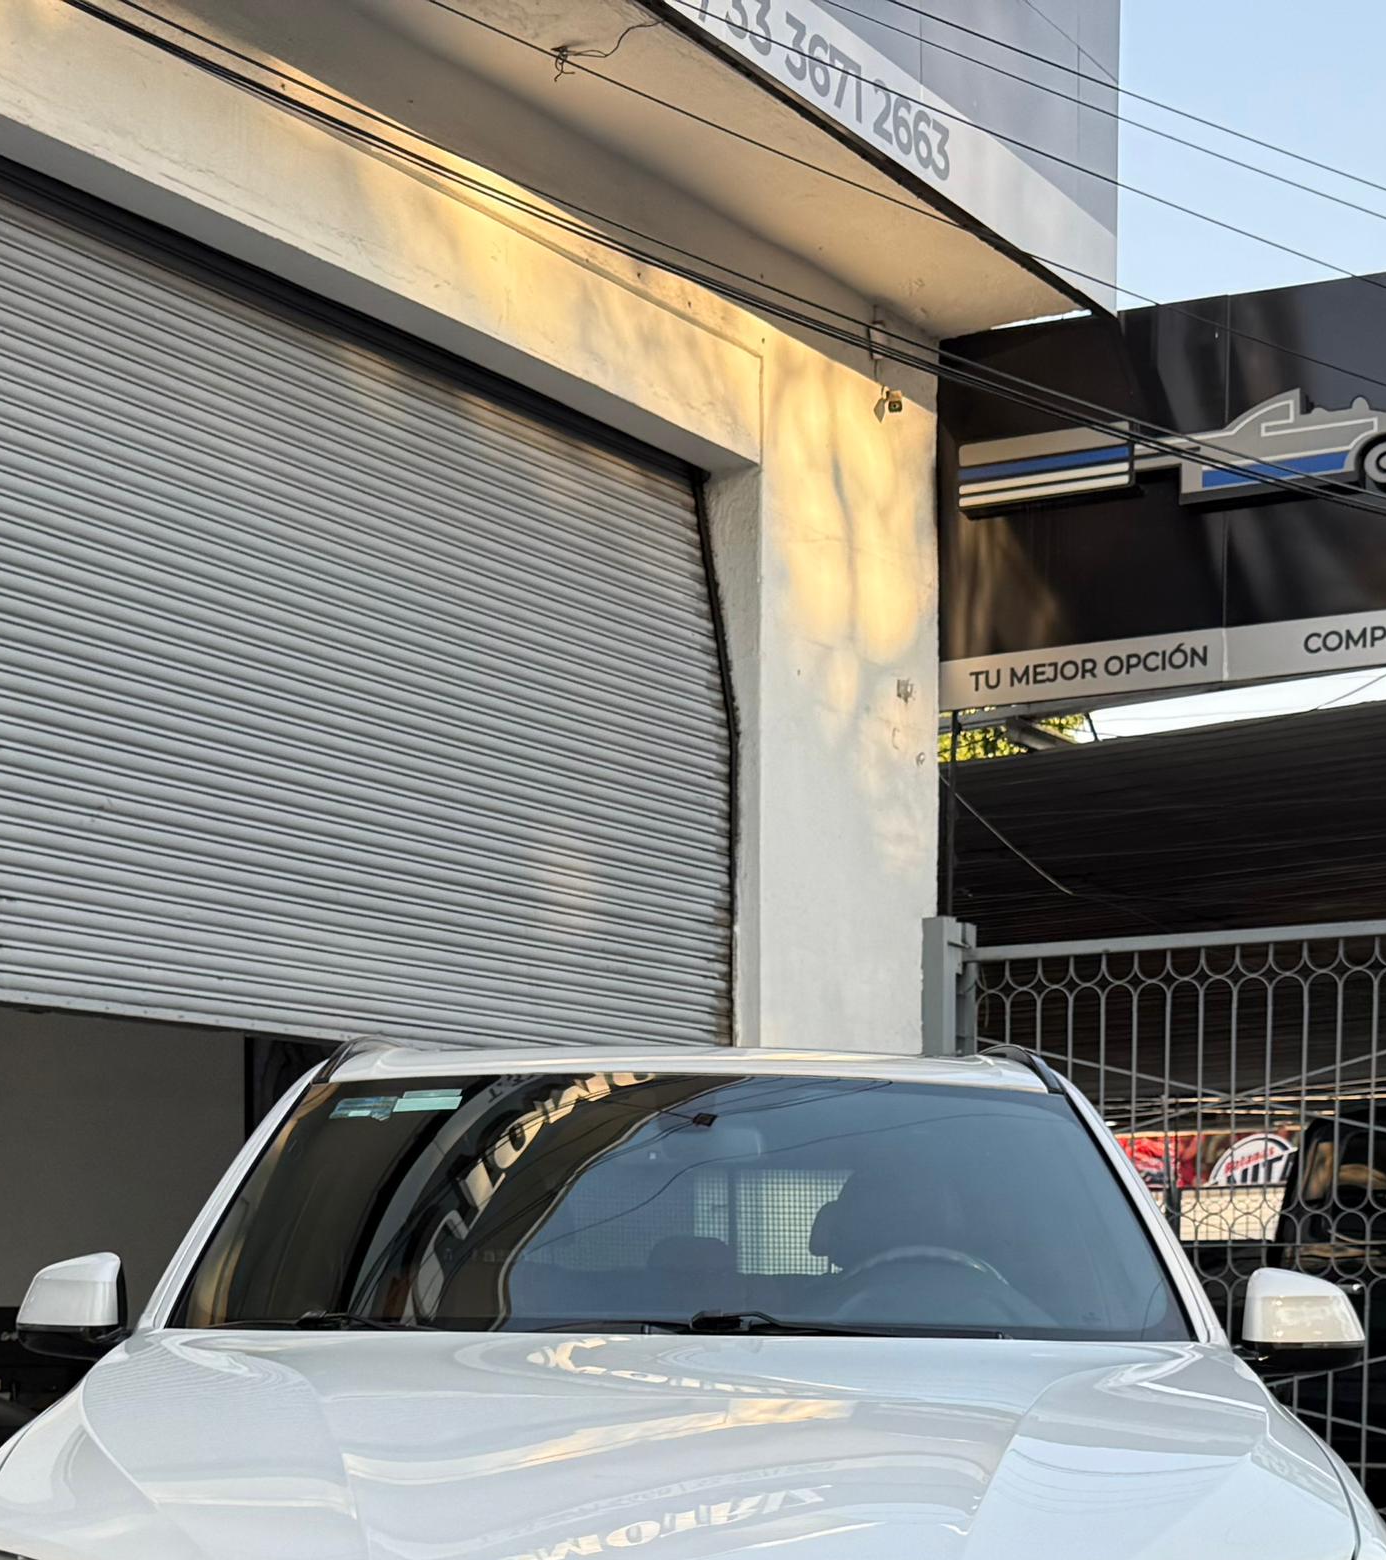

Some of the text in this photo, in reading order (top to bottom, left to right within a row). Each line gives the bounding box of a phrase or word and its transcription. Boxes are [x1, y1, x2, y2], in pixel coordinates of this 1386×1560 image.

[785, 11, 863, 124] 3671
[873, 78, 950, 181] 2663
[970, 643, 1209, 692] TU MEJOR OPCIÓN
